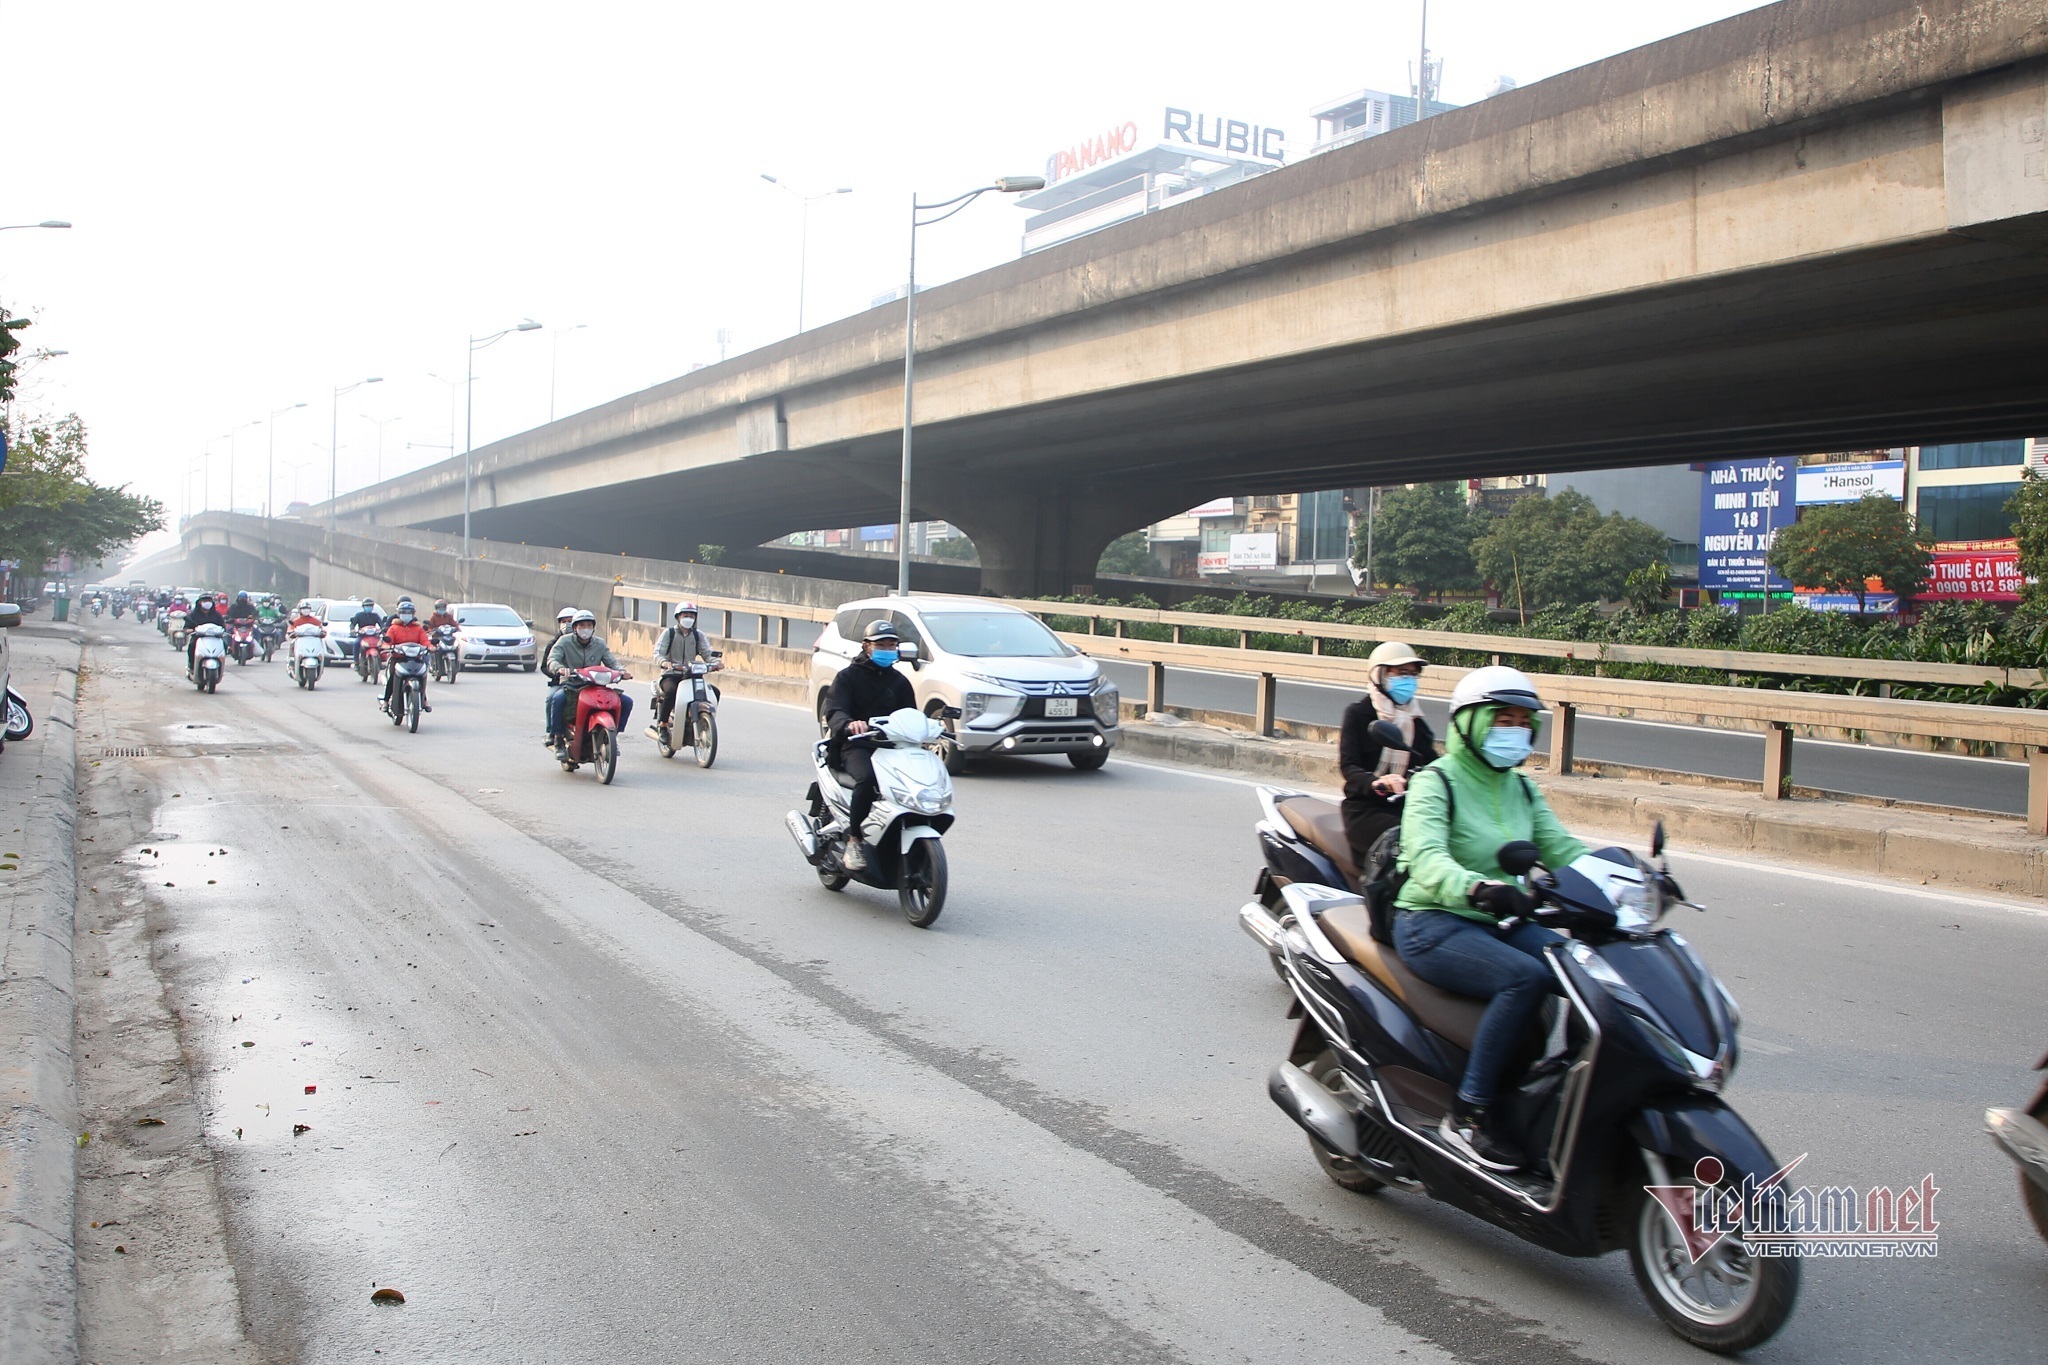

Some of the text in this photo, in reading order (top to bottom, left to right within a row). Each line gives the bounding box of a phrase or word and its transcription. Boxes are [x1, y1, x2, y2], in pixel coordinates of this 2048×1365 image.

[1163, 106, 1285, 160] RUBIC
[1056, 121, 1137, 180] PANANO
[1711, 460, 1784, 484] NHÀ THUỐC
[1829, 474, 1873, 487] Hansol
[1715, 493, 1746, 510] MINH
[1733, 511, 1758, 528] 148
[1705, 529, 1753, 552] NGUYỄN
[1940, 559, 1972, 579] THUÊ
[1975, 558, 1993, 578] CẢ
[1936, 581, 1967, 593] 0909
[1971, 580, 1994, 592] 812
[1999, 579, 2022, 592] 586
